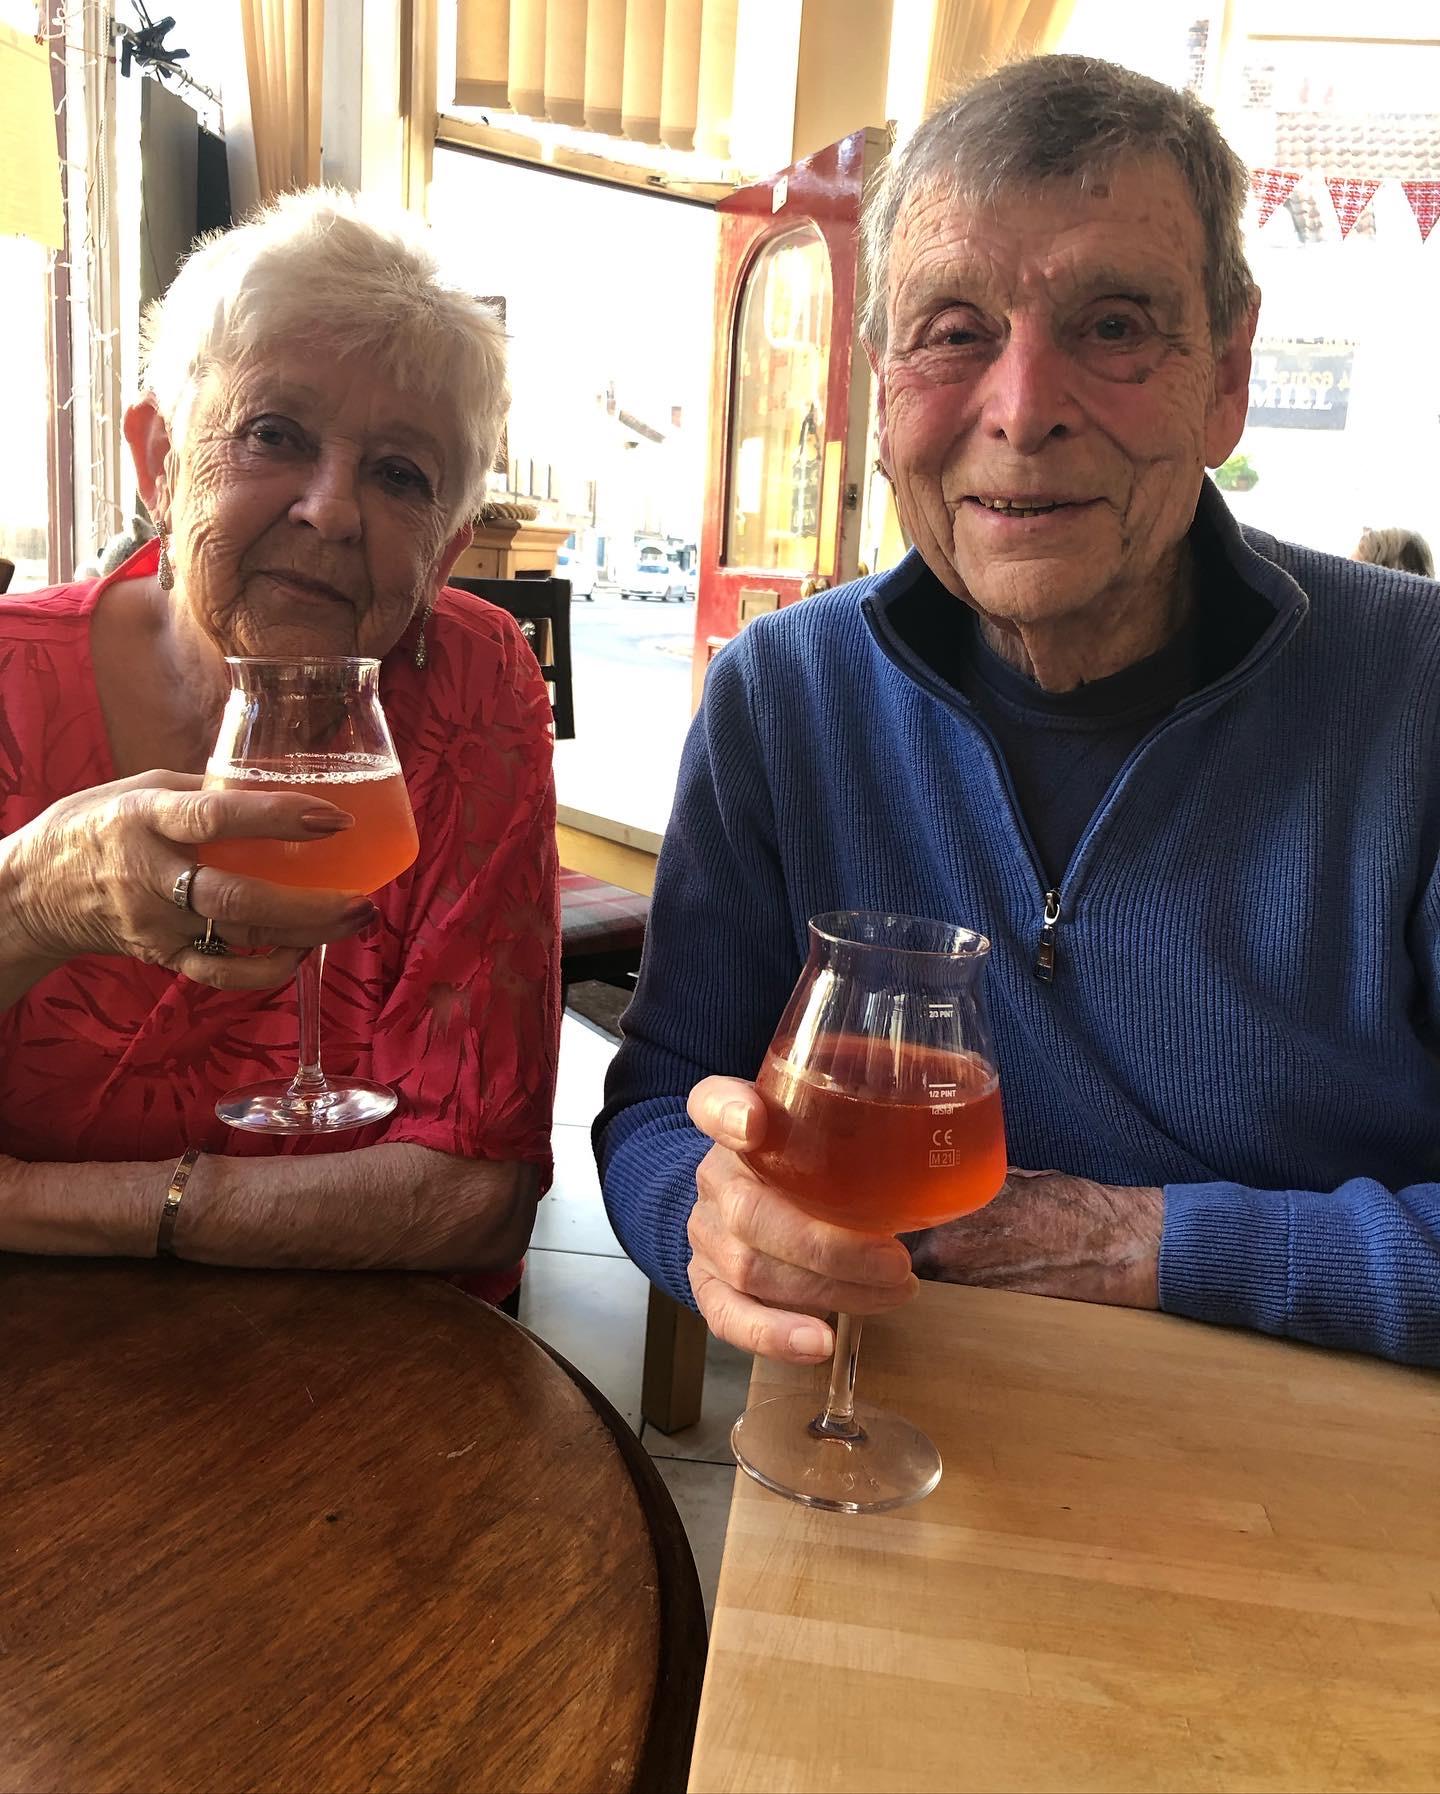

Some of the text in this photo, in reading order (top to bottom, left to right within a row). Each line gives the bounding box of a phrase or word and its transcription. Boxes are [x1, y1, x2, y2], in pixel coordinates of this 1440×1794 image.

[939, 1010, 953, 1018] PINT
[929, 1089, 956, 1098] 1/2 PINT
[932, 1129, 953, 1146] CE
